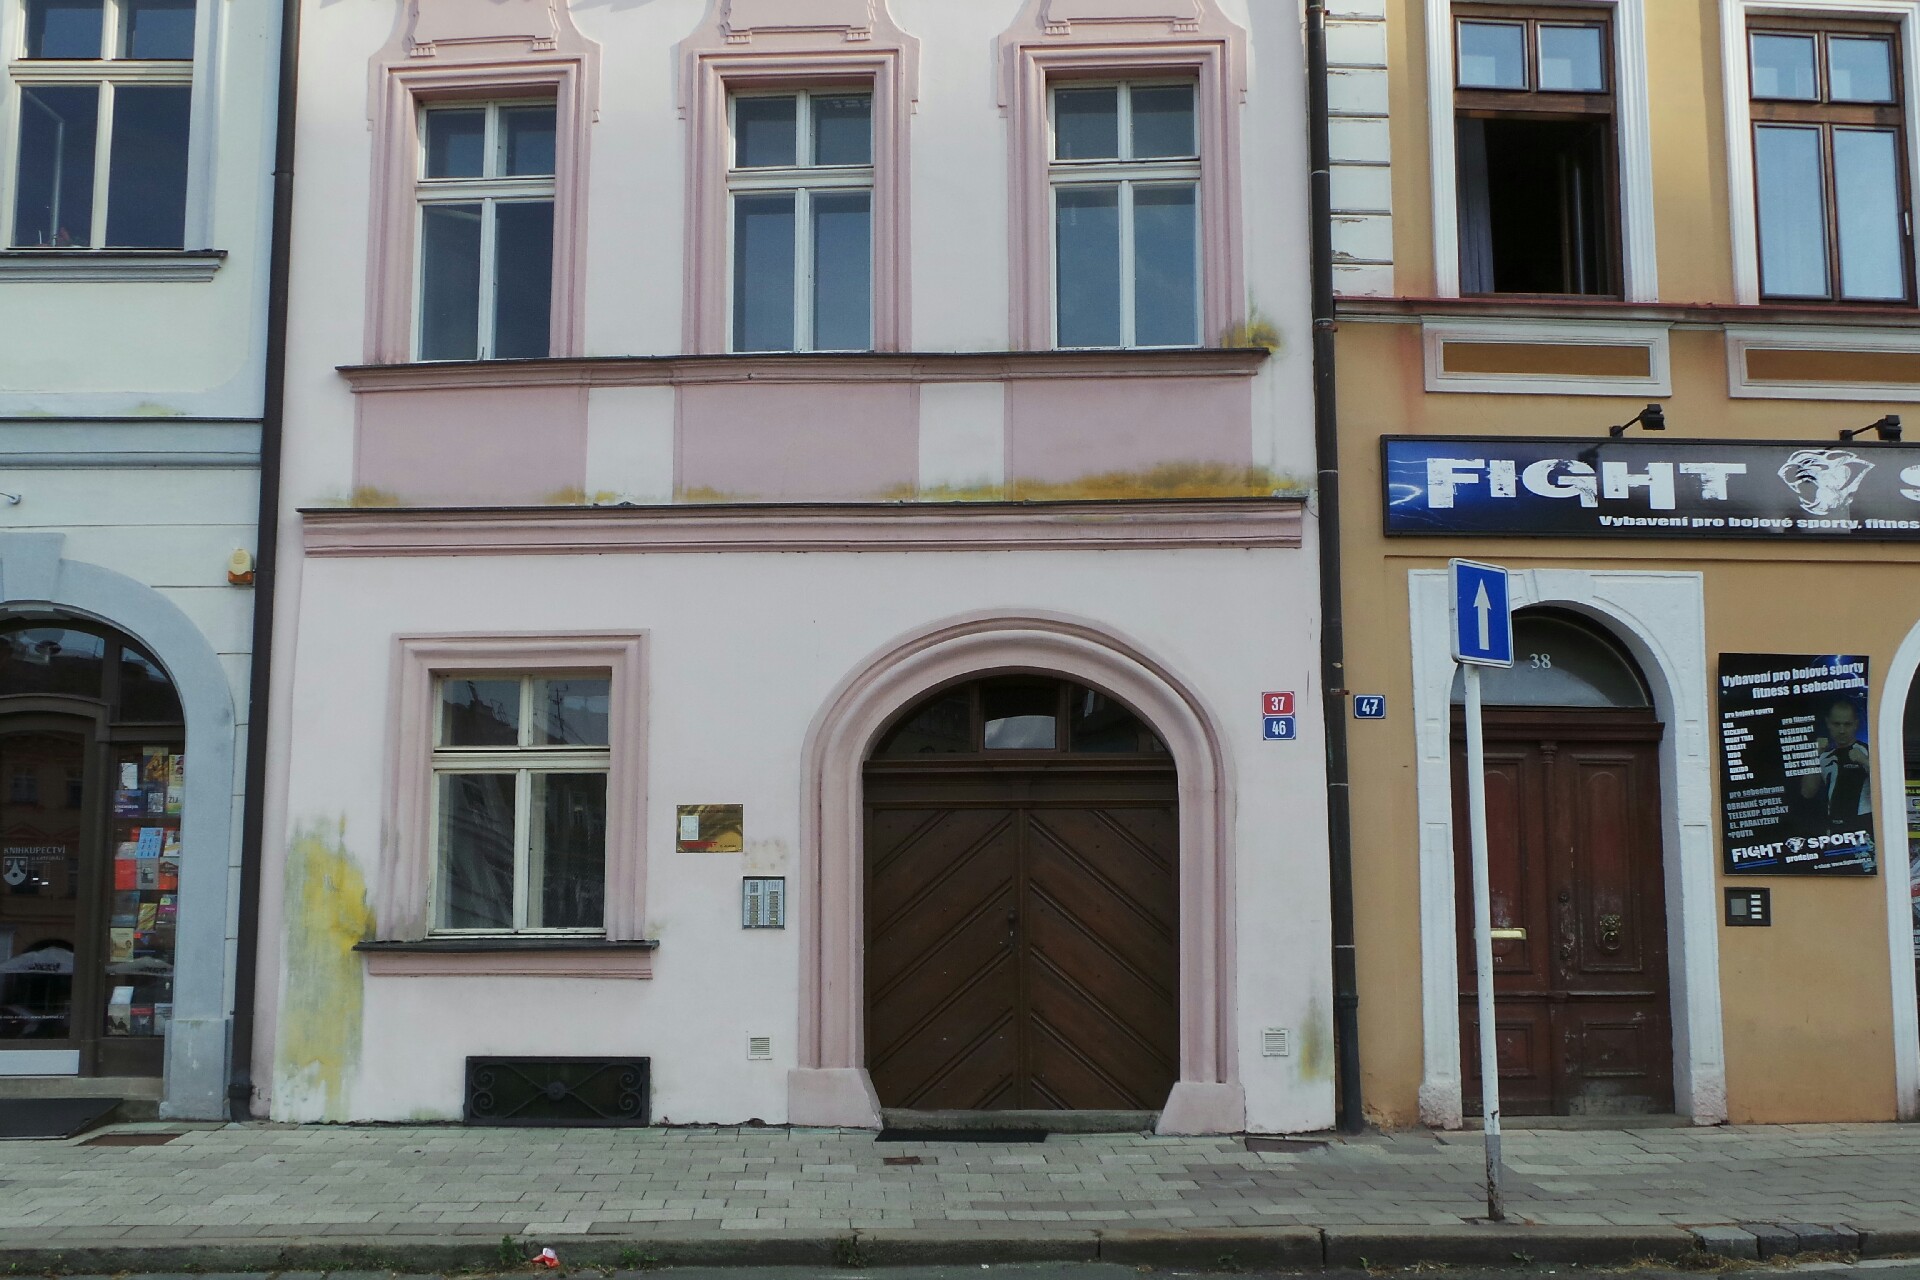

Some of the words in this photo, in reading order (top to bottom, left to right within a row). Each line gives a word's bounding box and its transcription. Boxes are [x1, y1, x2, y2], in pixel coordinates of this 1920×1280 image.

[1427, 458, 1747, 509] FIGHT
[1598, 515, 1688, 527] Vybavení
[1692, 518, 1725, 528] pro
[1728, 517, 1793, 529] bojové
[1796, 518, 1862, 531] sporty,
[1530, 653, 1552, 669] 38
[1721, 670, 1771, 688] Vybavení
[1772, 671, 1791, 683] pro
[1792, 664, 1829, 681] bojové
[1829, 661, 1865, 676] sporty
[1752, 685, 1790, 699] fitness
[1793, 685, 1801, 694] a
[1801, 676, 1865, 694] sebeobranu
[1271, 696, 1285, 711] 37
[1361, 699, 1379, 715] 47
[1271, 720, 1287, 735] 46
[1729, 791, 1741, 800] pro
[1726, 798, 1758, 811] OBRANNÉ
[1758, 797, 1783, 807] SPREJE
[3, 844, 66, 854] KNIHKUPECTVÍ
[1731, 842, 1784, 863] FIGHT
[1807, 829, 1867, 850] SPORT
[1785, 852, 1819, 864] prodejna
